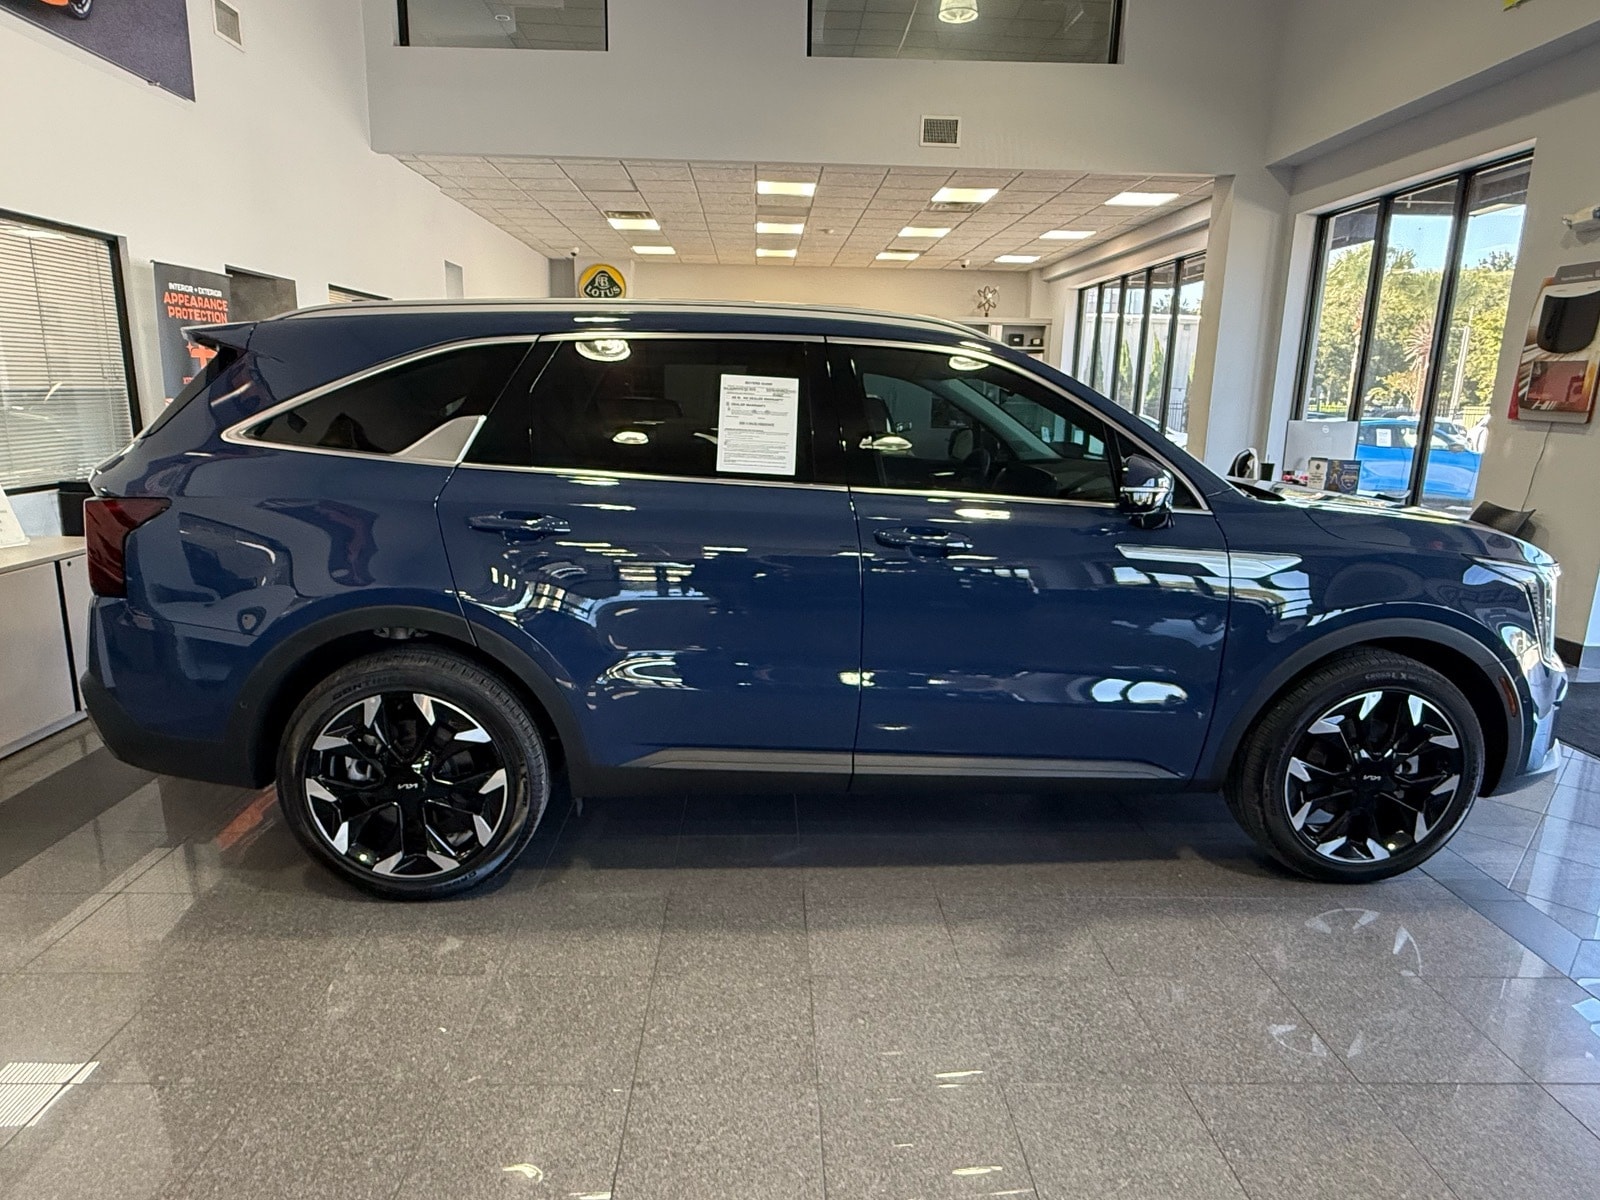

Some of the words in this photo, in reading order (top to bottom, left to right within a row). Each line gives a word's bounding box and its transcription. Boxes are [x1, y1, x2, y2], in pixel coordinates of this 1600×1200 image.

[163, 291, 228, 311] APPEARANCE
[586, 285, 620, 298] LOTUS
[167, 305, 228, 324] PROTECTION
